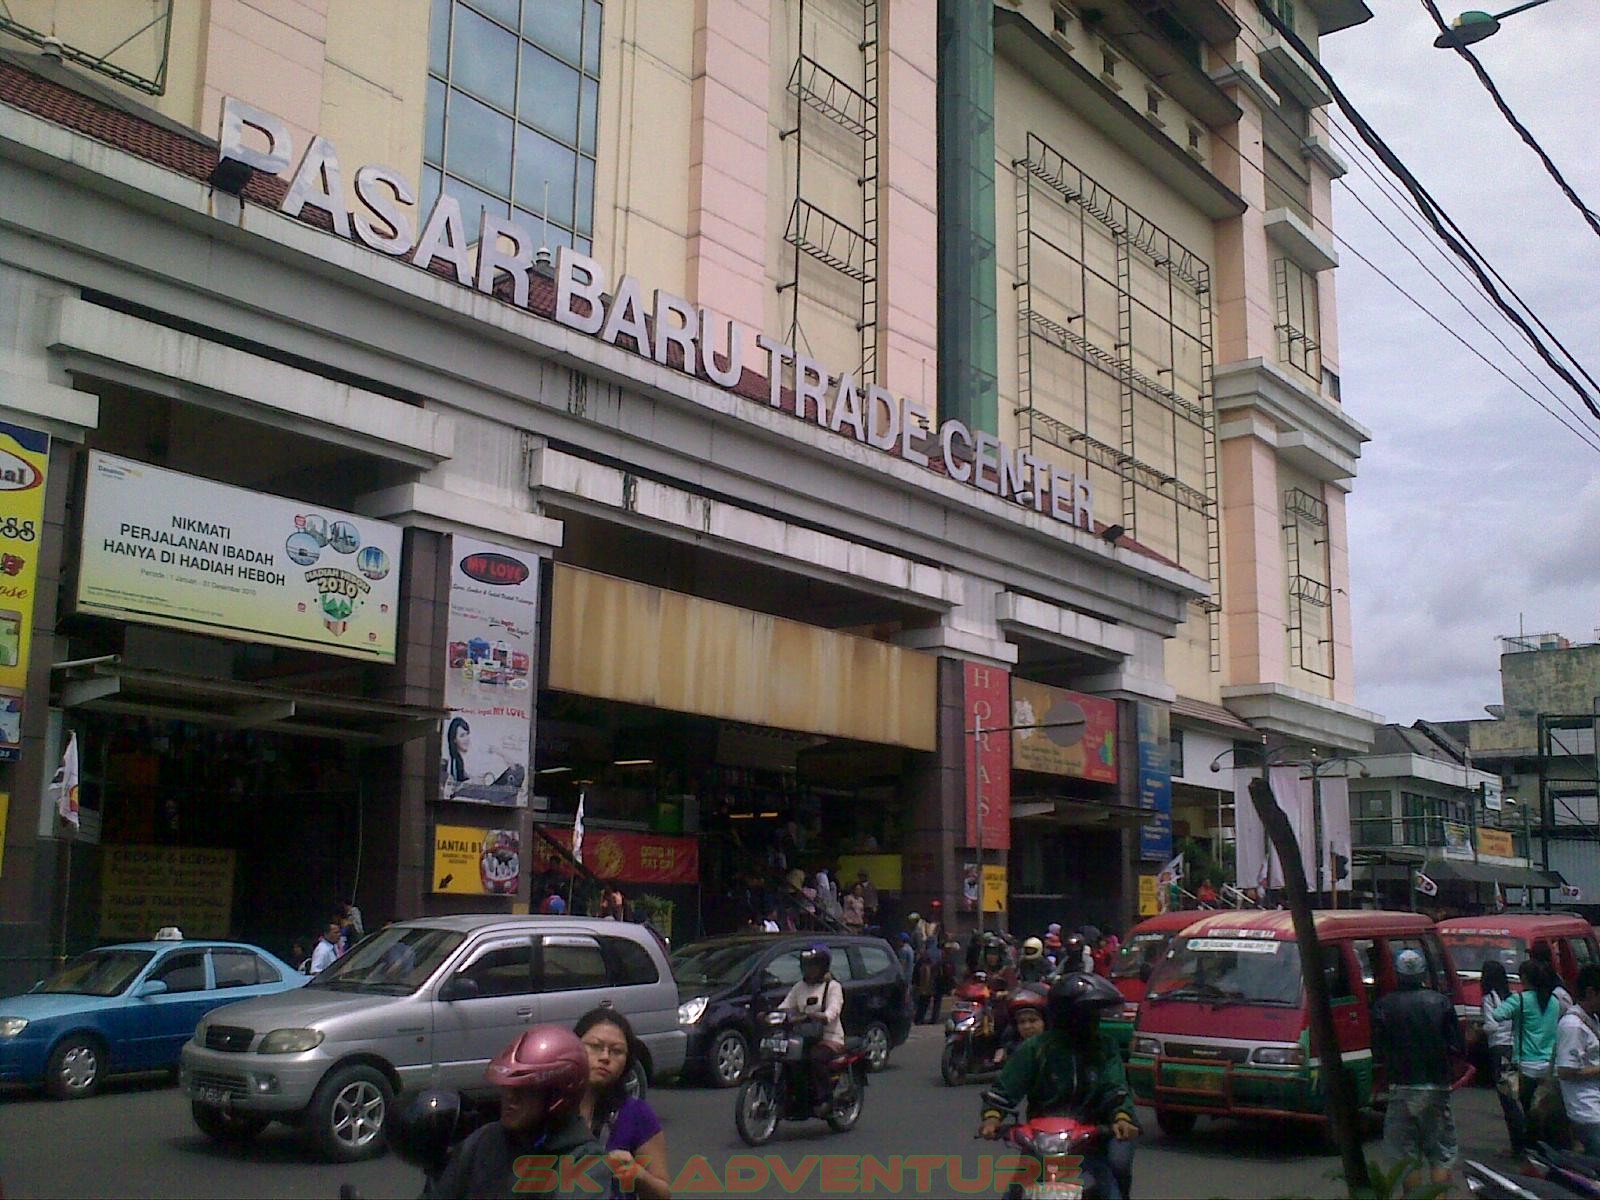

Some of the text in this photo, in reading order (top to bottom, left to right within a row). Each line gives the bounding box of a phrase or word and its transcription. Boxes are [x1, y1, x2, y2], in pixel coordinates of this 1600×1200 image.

[215, 96, 1095, 532] PASAR BARU TRADE CENTER
[0, 466, 25, 485] al
[0, 516, 35, 542] ss
[171, 515, 231, 540] NIKMATI
[120, 523, 274, 567] PERJALANAN IBADAH
[103, 538, 286, 587] HANYA DI HADIAH HEBOH
[317, 577, 359, 599] 2010
[437, 839, 469, 853] LANTAI
